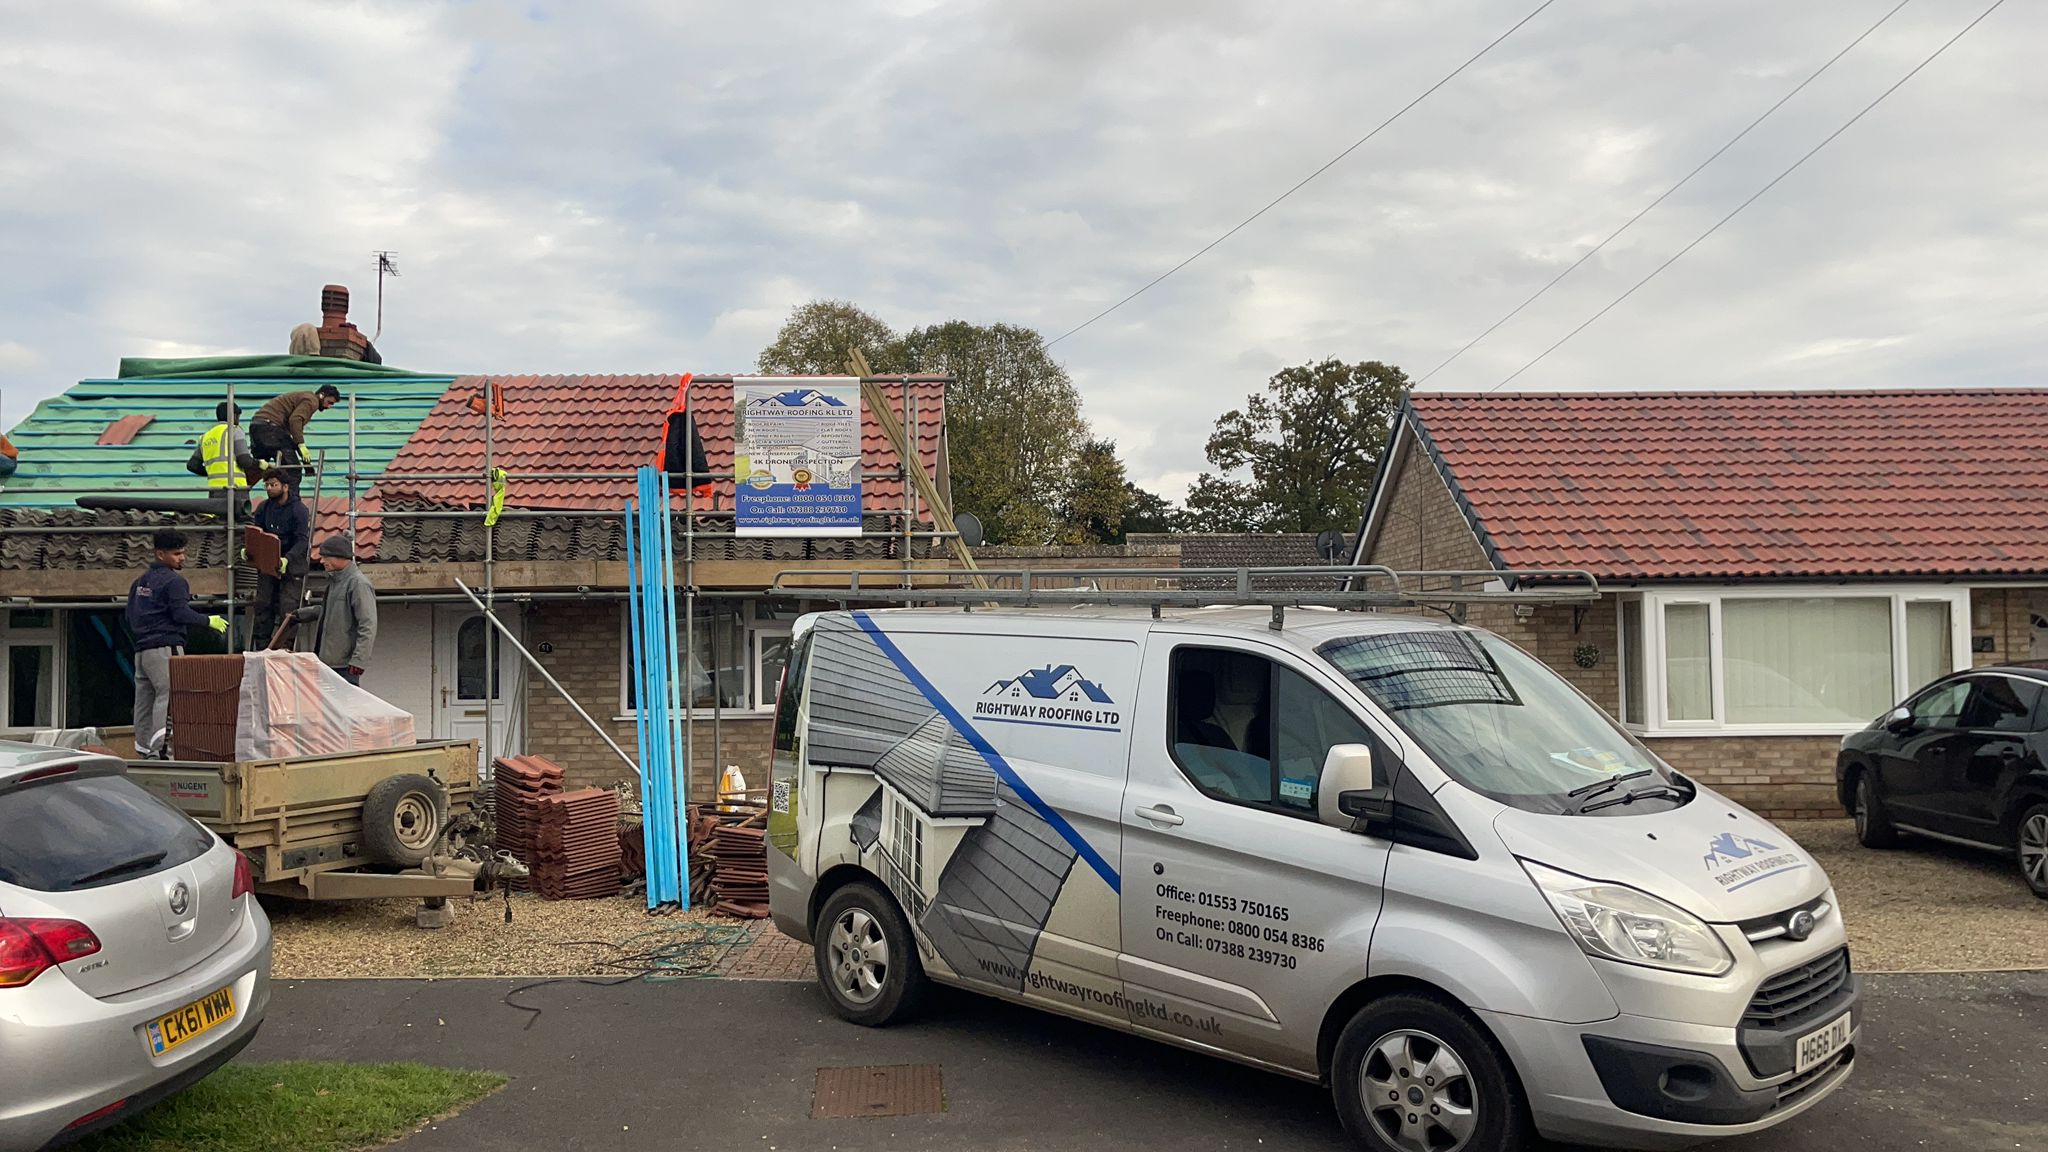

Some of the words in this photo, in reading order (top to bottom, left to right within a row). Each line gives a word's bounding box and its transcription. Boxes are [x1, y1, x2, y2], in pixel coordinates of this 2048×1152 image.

[742, 495, 790, 503] Freephone:
[976, 702, 1036, 718] RIGHTWAY
[1038, 706, 1092, 722] ROOFING
[1096, 710, 1120, 724] LTD
[178, 782, 207, 790] NUGENT
[1714, 862, 1760, 886] RIGHTWAY
[1156, 884, 1195, 903] Office:
[1198, 892, 1237, 912] 01553
[1240, 900, 1289, 922] 750165
[1156, 905, 1225, 931] Freephone:
[1228, 920, 1260, 939] 0800
[1264, 928, 1288, 944] 054
[1292, 933, 1325, 952] 8386
[1156, 928, 1174, 942] On
[1177, 931, 1202, 948] Call:
[1206, 938, 1244, 958] 07388
[1248, 947, 1297, 970] 239730
[79, 960, 109, 973] ASTRA
[978, 958, 1224, 1036] www.rightwayroofingltd.co.uk
[164, 1004, 202, 1043] CK61
